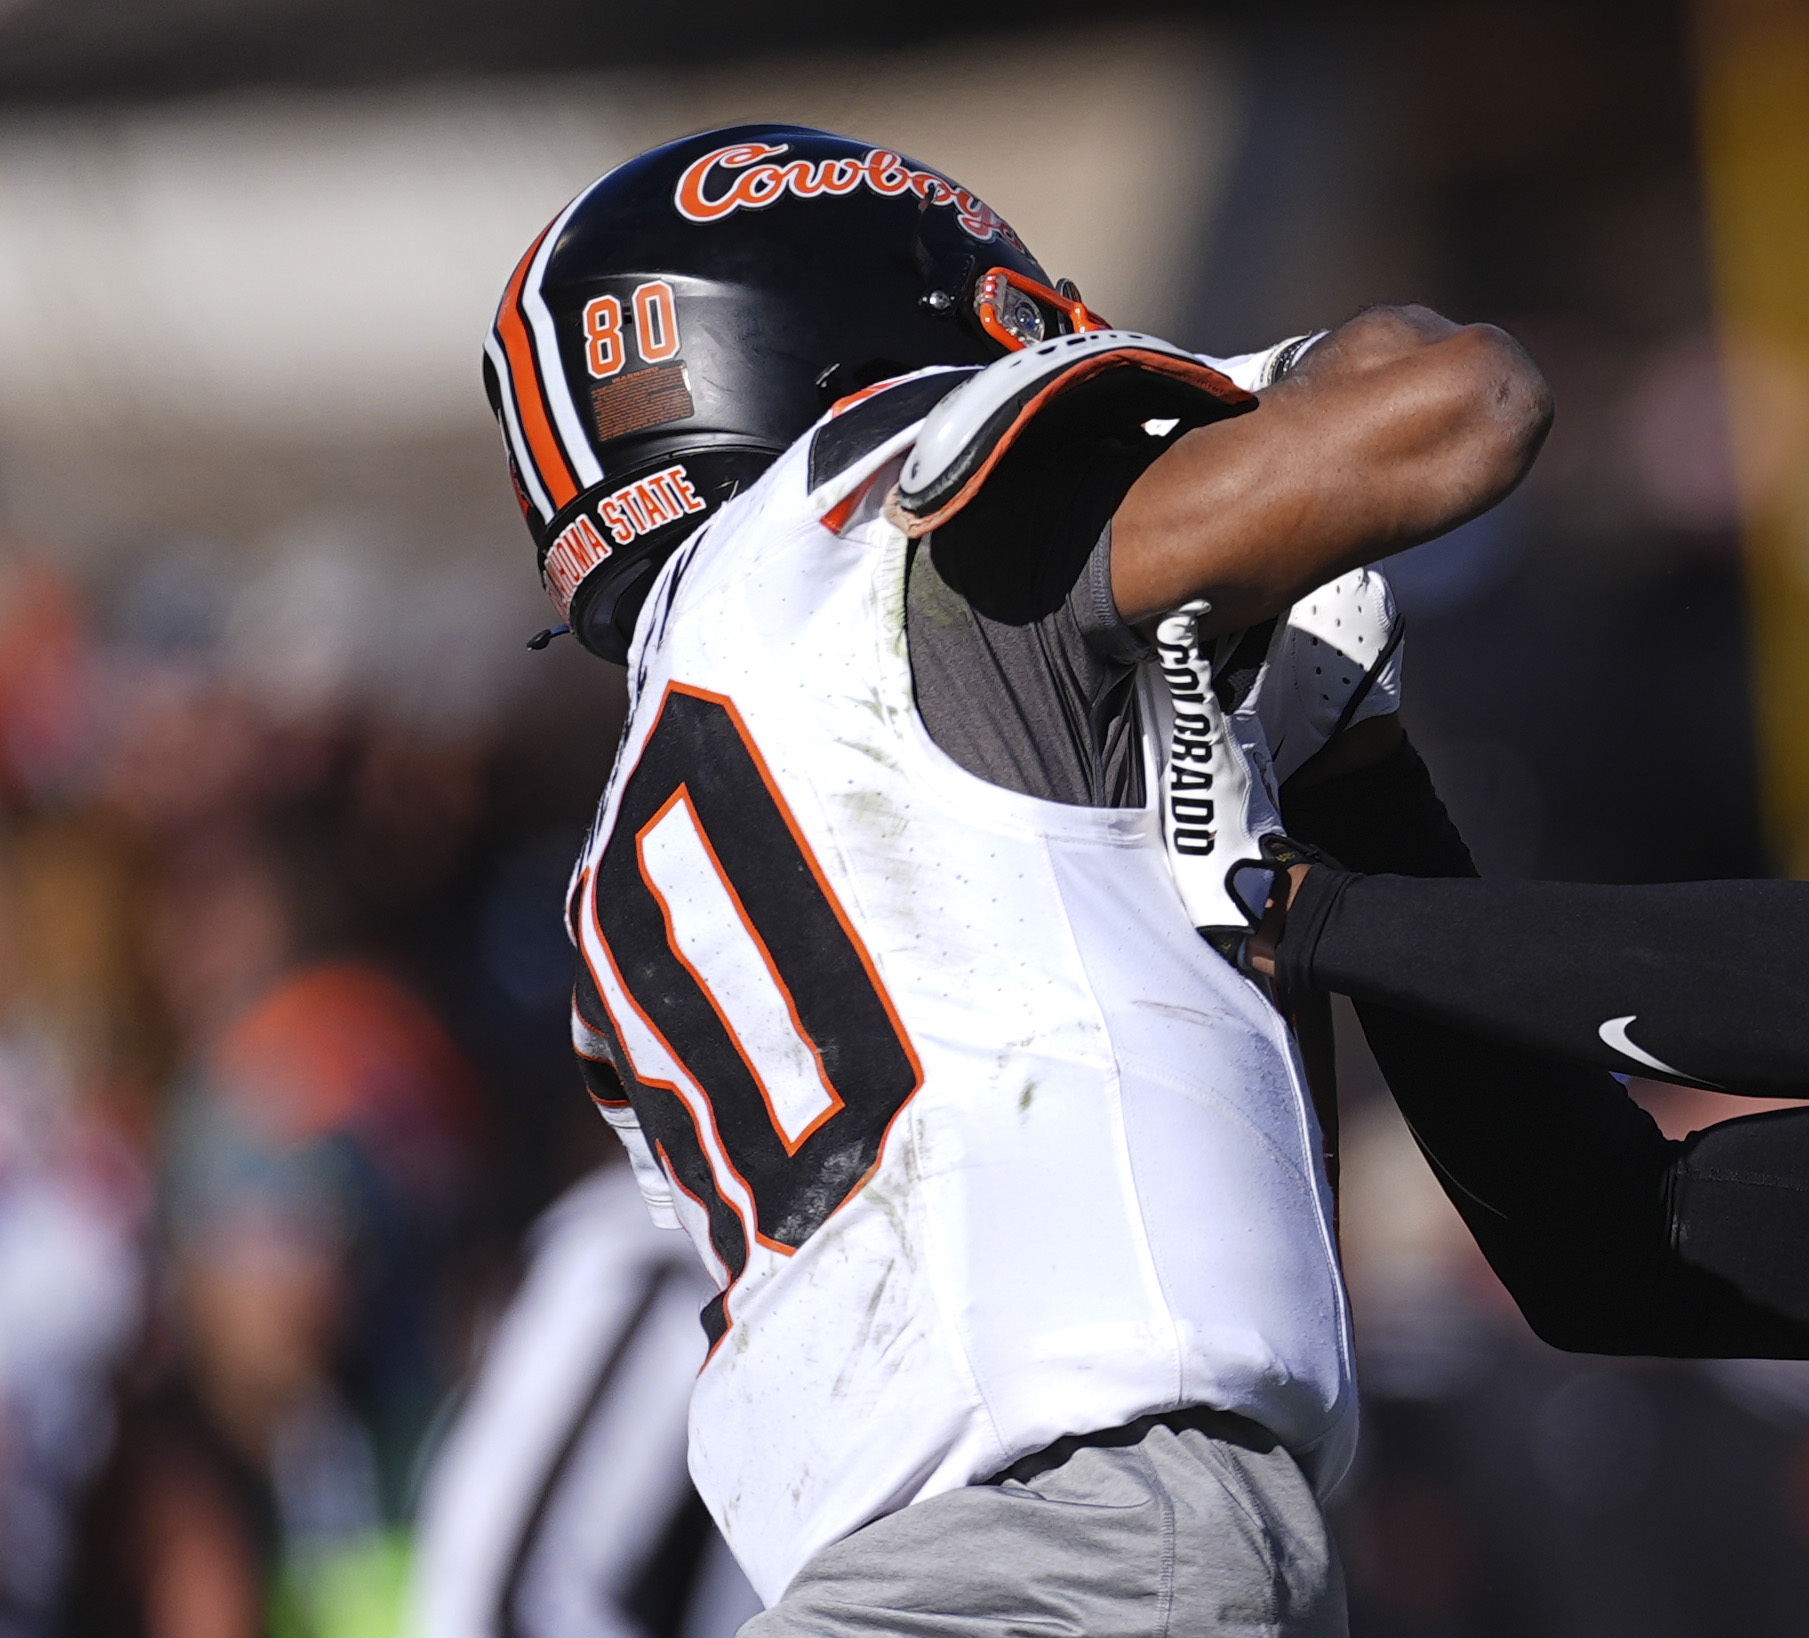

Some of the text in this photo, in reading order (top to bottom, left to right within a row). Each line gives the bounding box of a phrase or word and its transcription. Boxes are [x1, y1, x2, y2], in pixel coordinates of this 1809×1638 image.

[582, 280, 680, 379] 80
[597, 464, 707, 546] STATE
[1156, 642, 1216, 857] COLORADO
